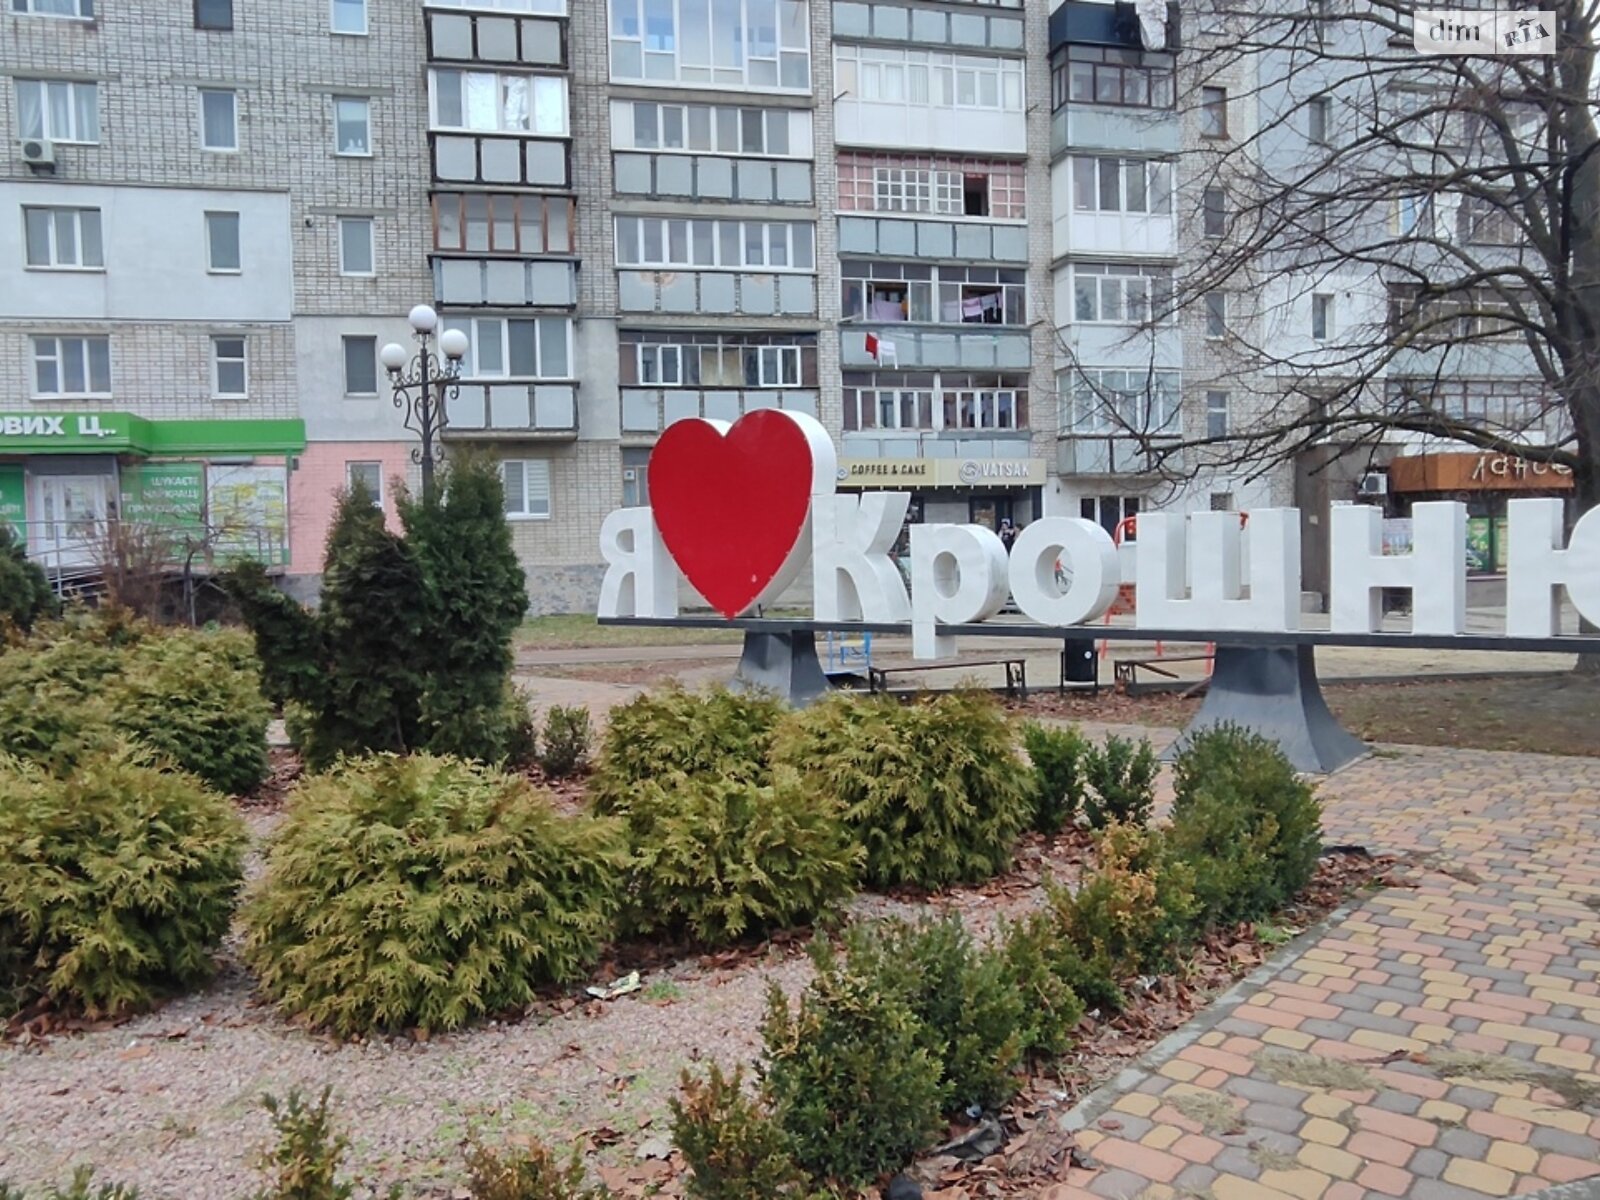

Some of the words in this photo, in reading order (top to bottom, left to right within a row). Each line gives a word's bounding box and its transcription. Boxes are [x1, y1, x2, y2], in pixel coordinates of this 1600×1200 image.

[0, 416, 65, 435] ВИХ
[851, 463, 888, 475] COFFEE
[891, 463, 898, 475] &
[901, 463, 926, 475] CAKE
[982, 463, 1030, 478] VATSAK
[597, 506, 678, 619] Я
